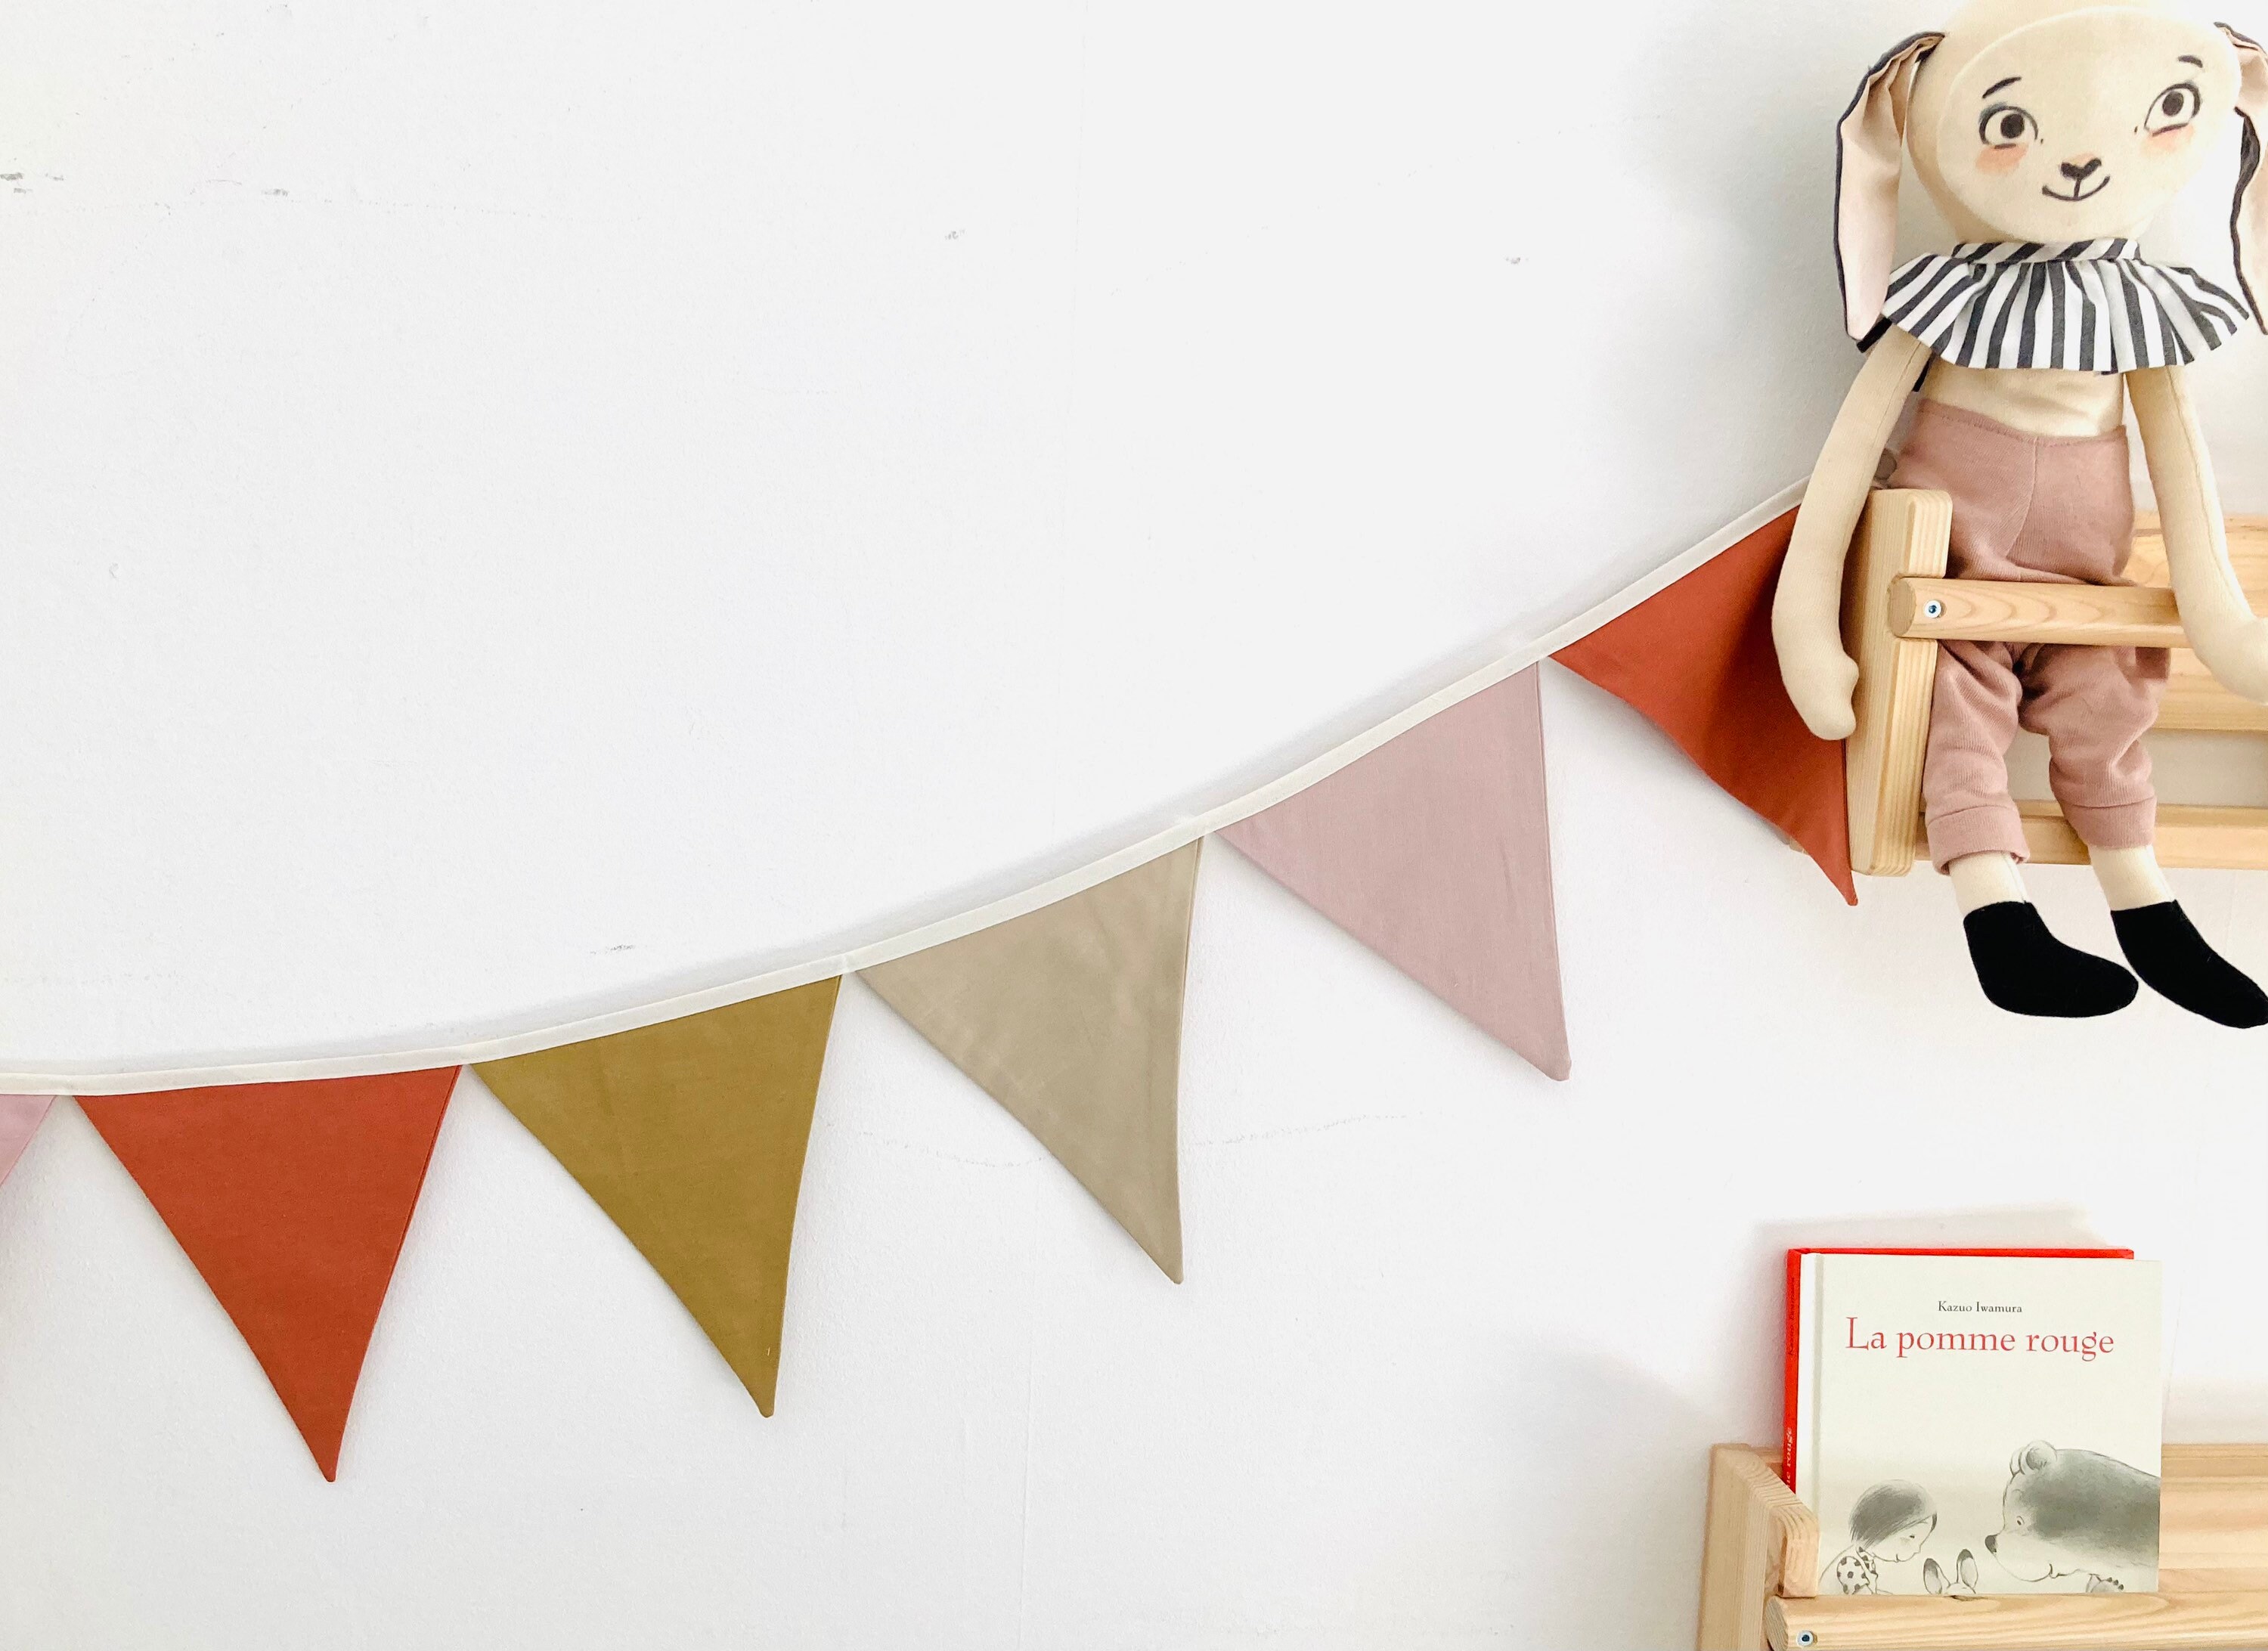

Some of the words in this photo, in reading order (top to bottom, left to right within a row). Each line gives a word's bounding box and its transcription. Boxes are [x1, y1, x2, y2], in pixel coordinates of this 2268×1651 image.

[1938, 1300, 1972, 1312] Kazuo
[1975, 1301, 2022, 1313] Iwamura
[1845, 1316, 1887, 1351] La
[1896, 1332, 2015, 1358] pomme
[2026, 1330, 2114, 1361] rouge
